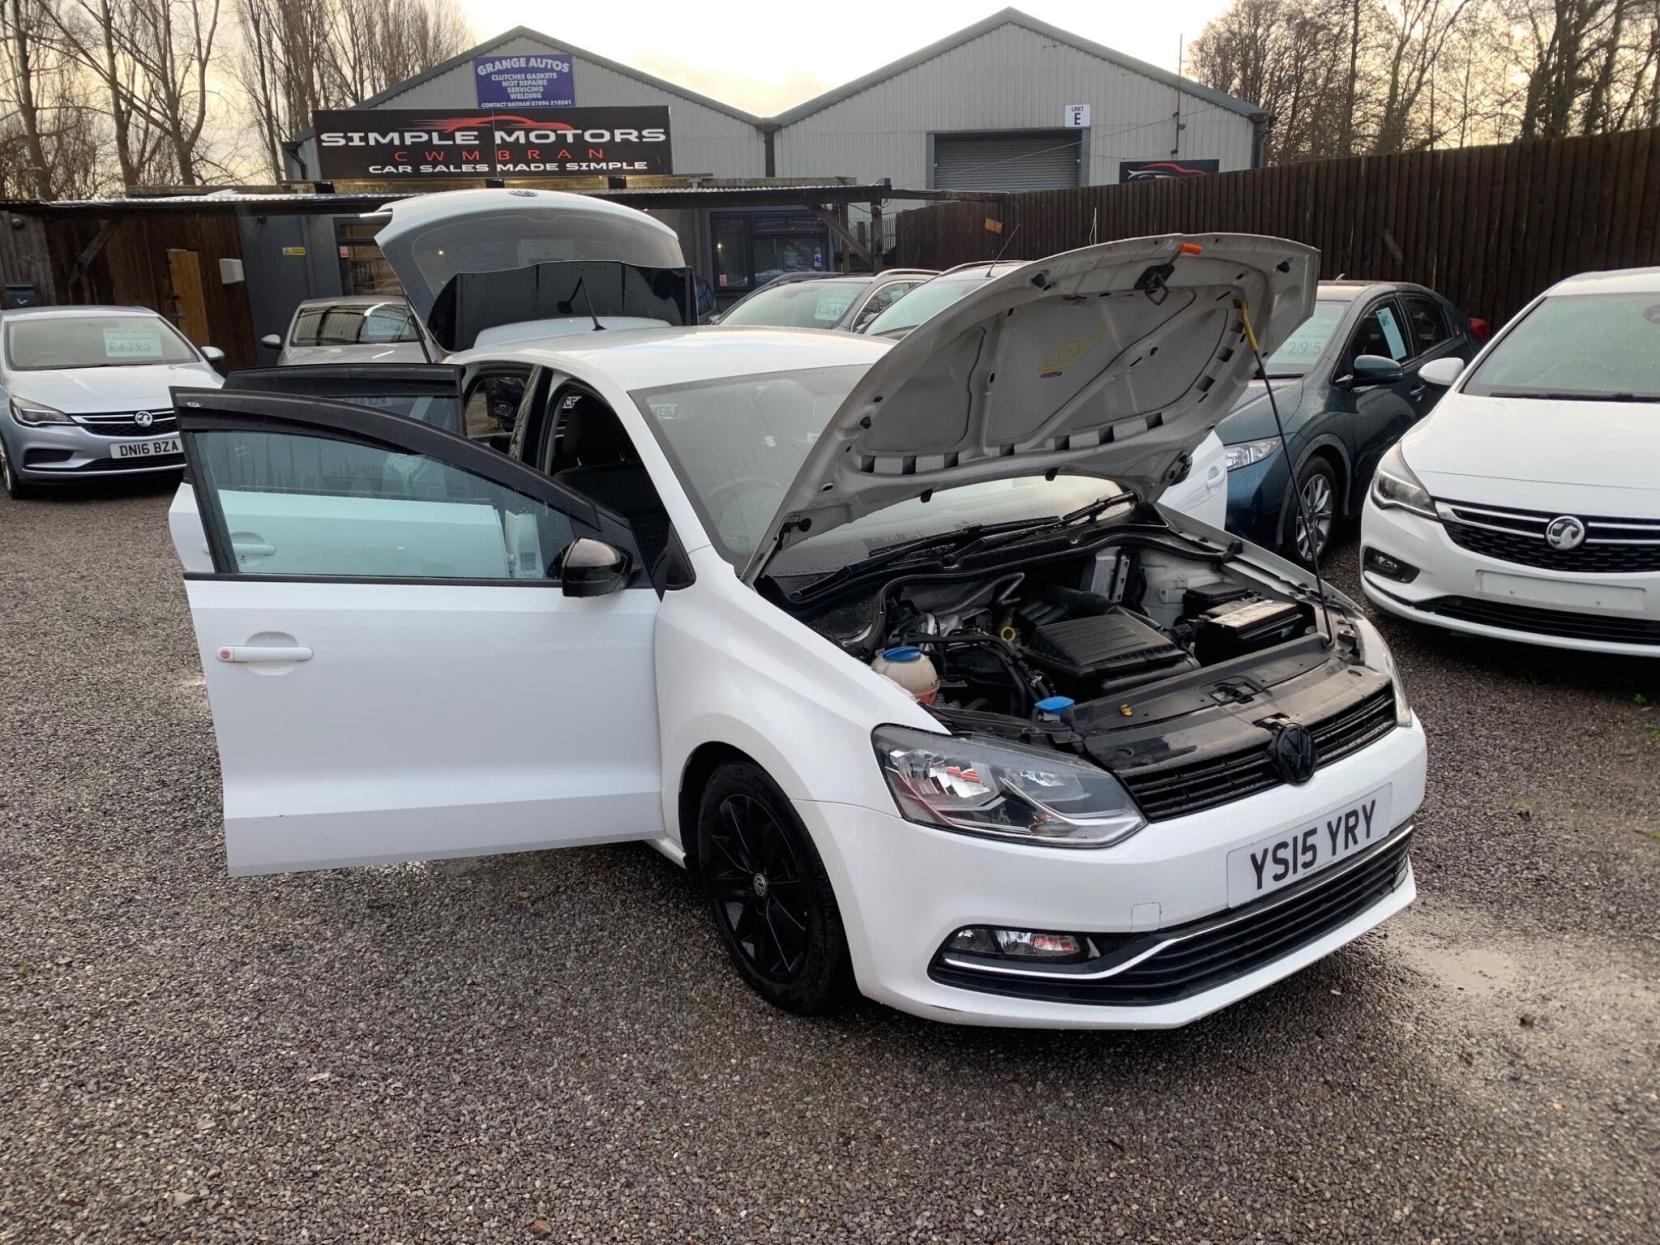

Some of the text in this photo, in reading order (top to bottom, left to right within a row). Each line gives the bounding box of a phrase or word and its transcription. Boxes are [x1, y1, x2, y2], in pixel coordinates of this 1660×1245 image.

[477, 57, 570, 76] GRANGE AUTOS
[491, 73, 525, 81] CLUTCHES
[1074, 112, 1081, 125] E
[320, 128, 666, 147] SIMPLE MOTORS
[368, 161, 648, 174] CAR SALES MADE SIMPLE
[119, 440, 179, 456] DN16 BZA
[1250, 799, 1377, 890] YS15 YRY
